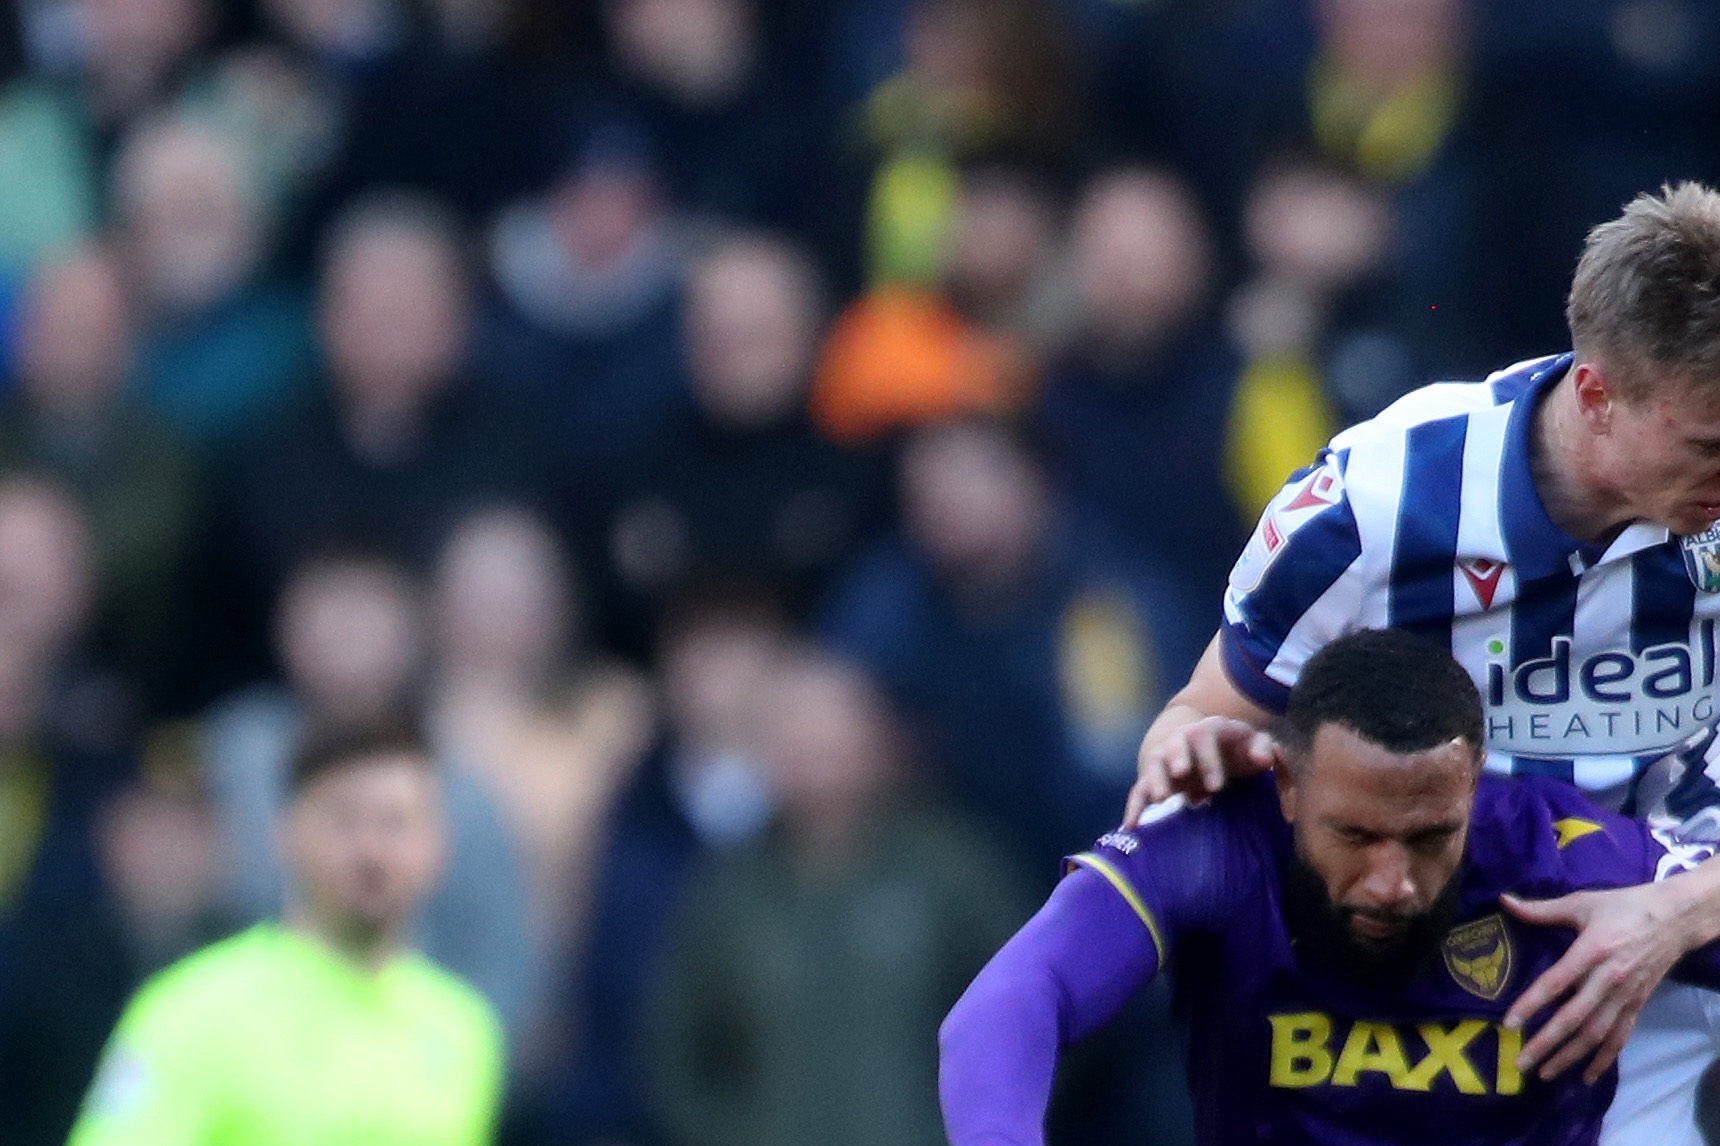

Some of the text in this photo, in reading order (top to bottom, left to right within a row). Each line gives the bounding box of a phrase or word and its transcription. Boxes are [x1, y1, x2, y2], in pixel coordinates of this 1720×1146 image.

[1487, 618, 1716, 707] ideal
[1487, 695, 1714, 740] HEATING
[1267, 1011, 1525, 1096] BAXI
